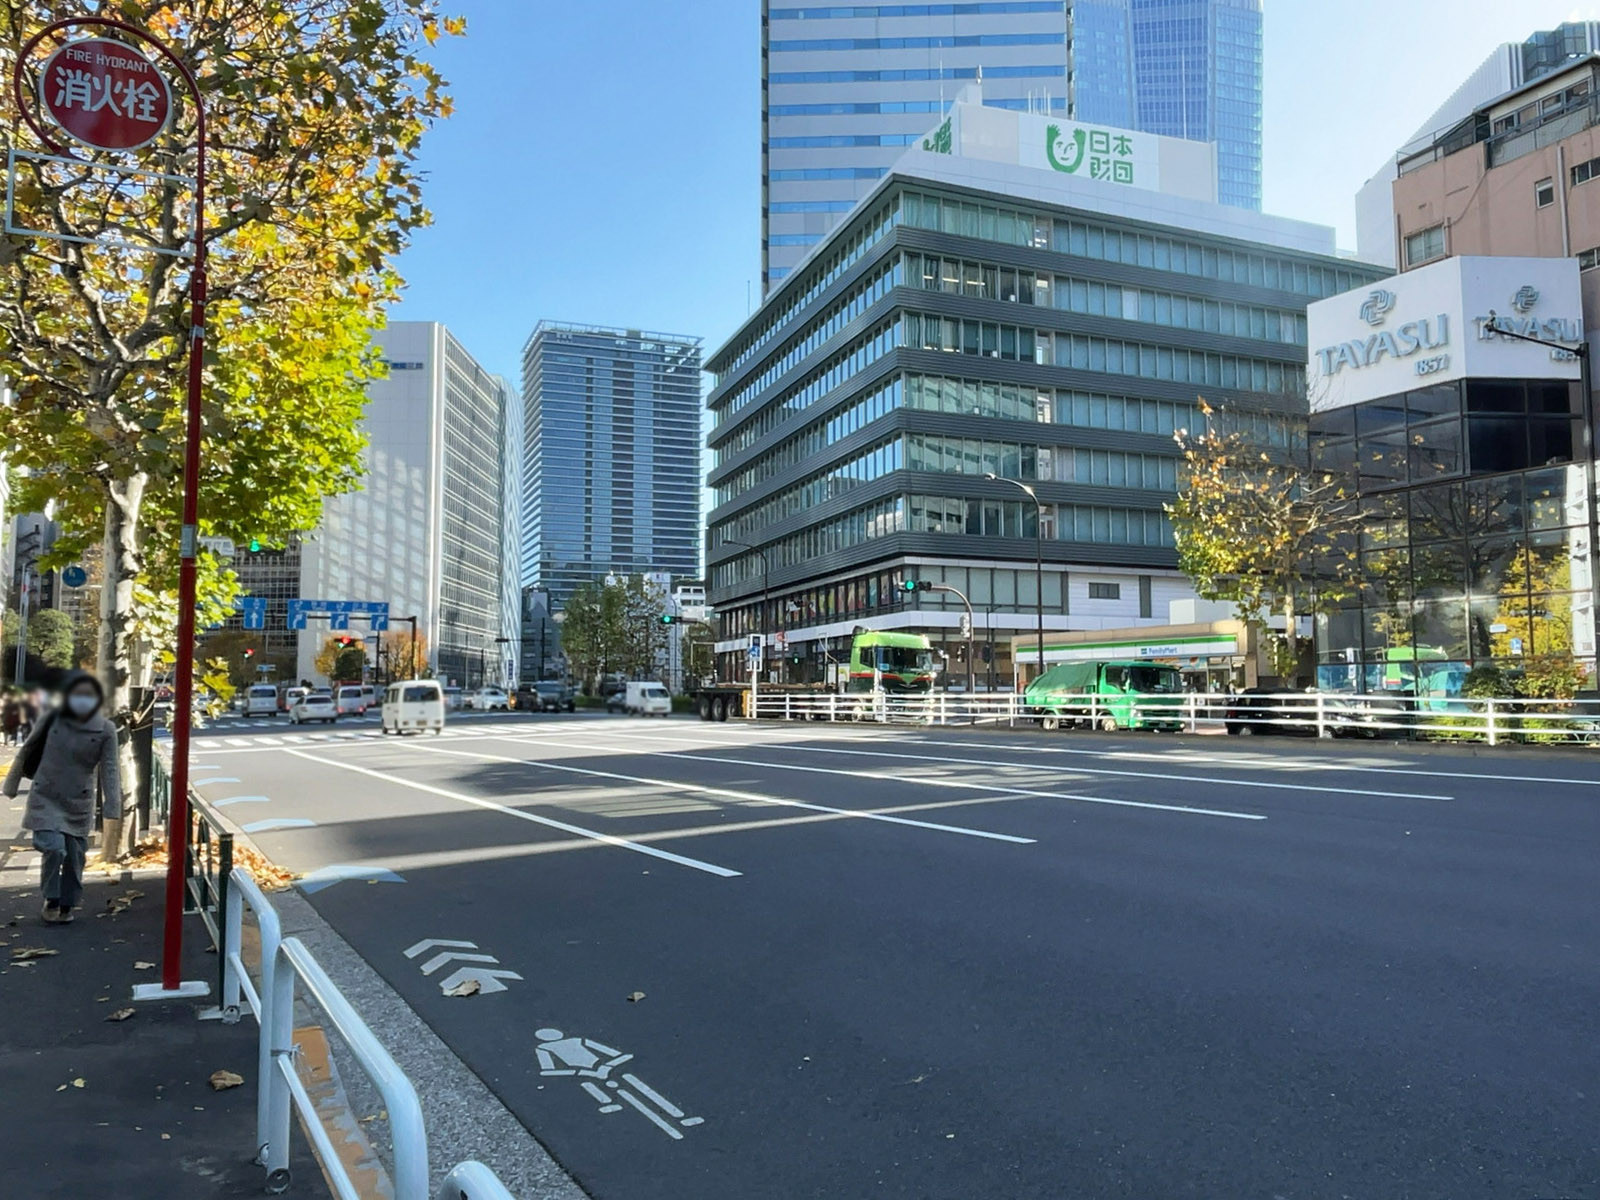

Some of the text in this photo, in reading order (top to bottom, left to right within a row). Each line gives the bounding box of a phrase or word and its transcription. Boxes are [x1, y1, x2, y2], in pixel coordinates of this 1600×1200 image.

[66, 48, 149, 74] FIRE HYDRANT
[54, 66, 160, 122] 消火栓
[1089, 129, 1133, 157] 日本
[1089, 155, 1133, 184] 財団
[1315, 313, 1449, 377] TAYASU
[1414, 353, 1449, 377] 1857
